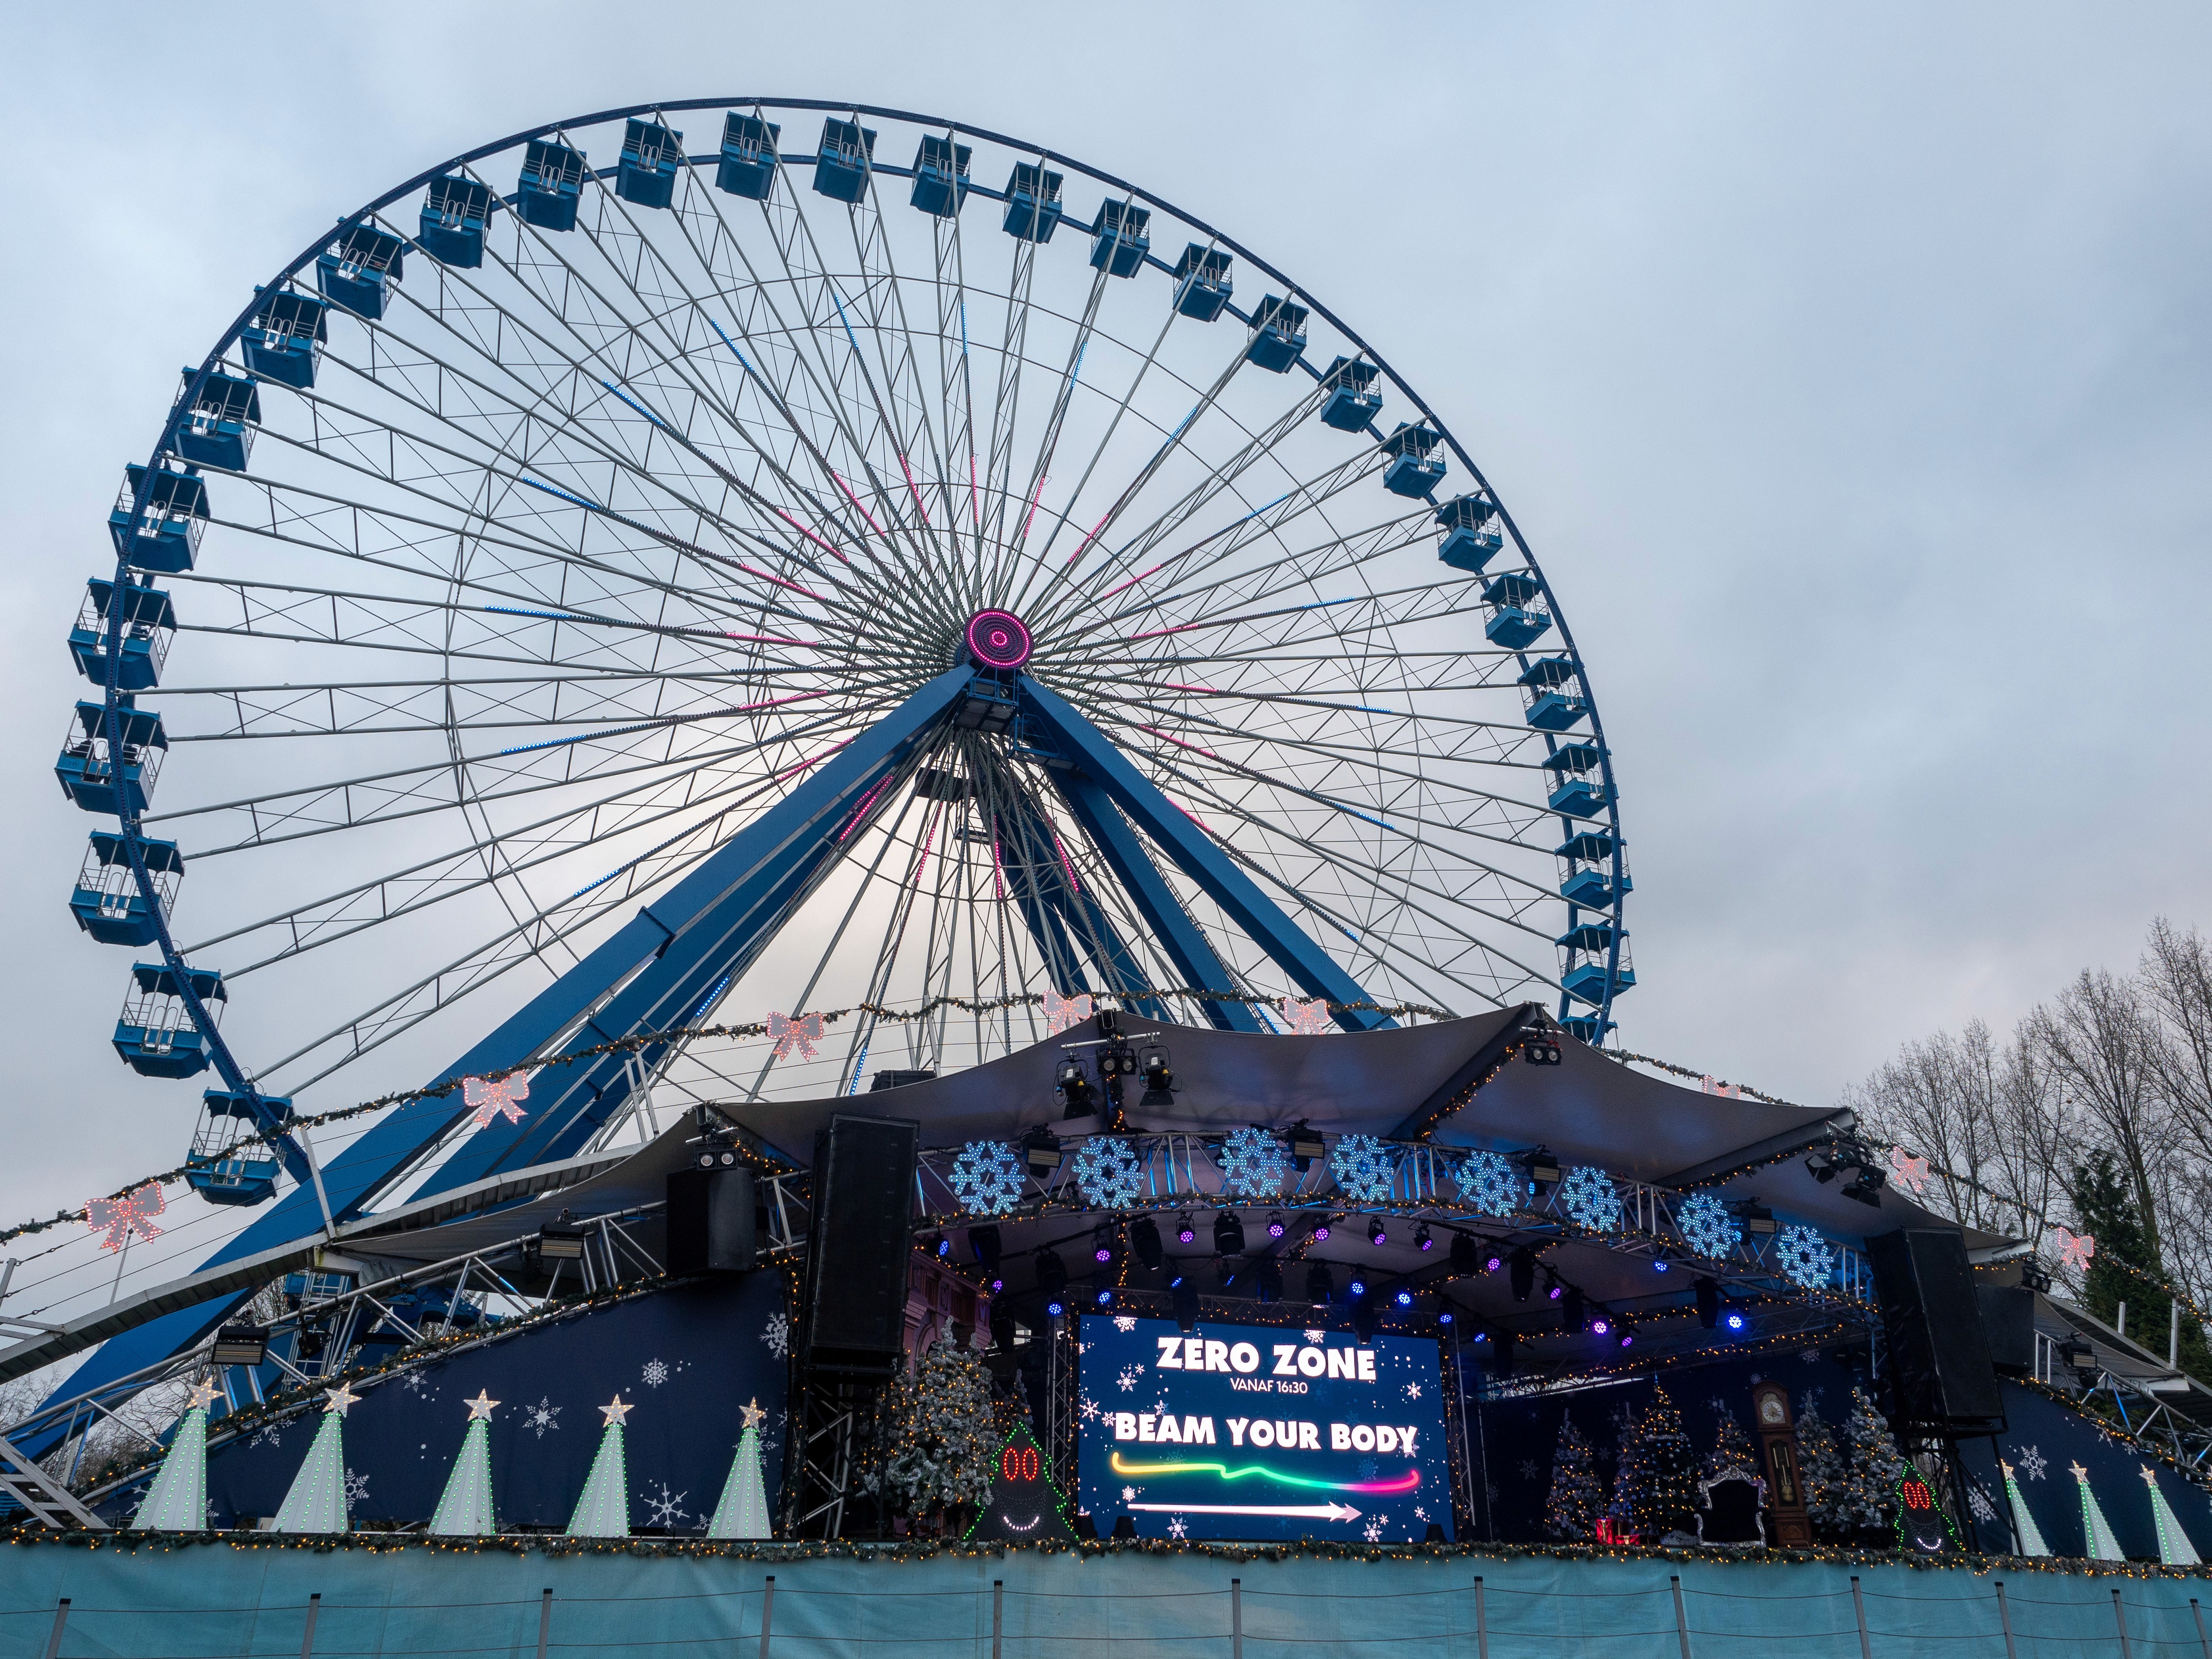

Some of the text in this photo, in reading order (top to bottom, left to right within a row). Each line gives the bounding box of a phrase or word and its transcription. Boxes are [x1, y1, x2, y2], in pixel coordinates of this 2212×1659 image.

[1156, 1337, 1376, 1380] ZERO ZONE
[1230, 1377, 1308, 1394] VANAF 16:30
[1115, 1412, 1418, 1453] BEAM YOUR BODY
